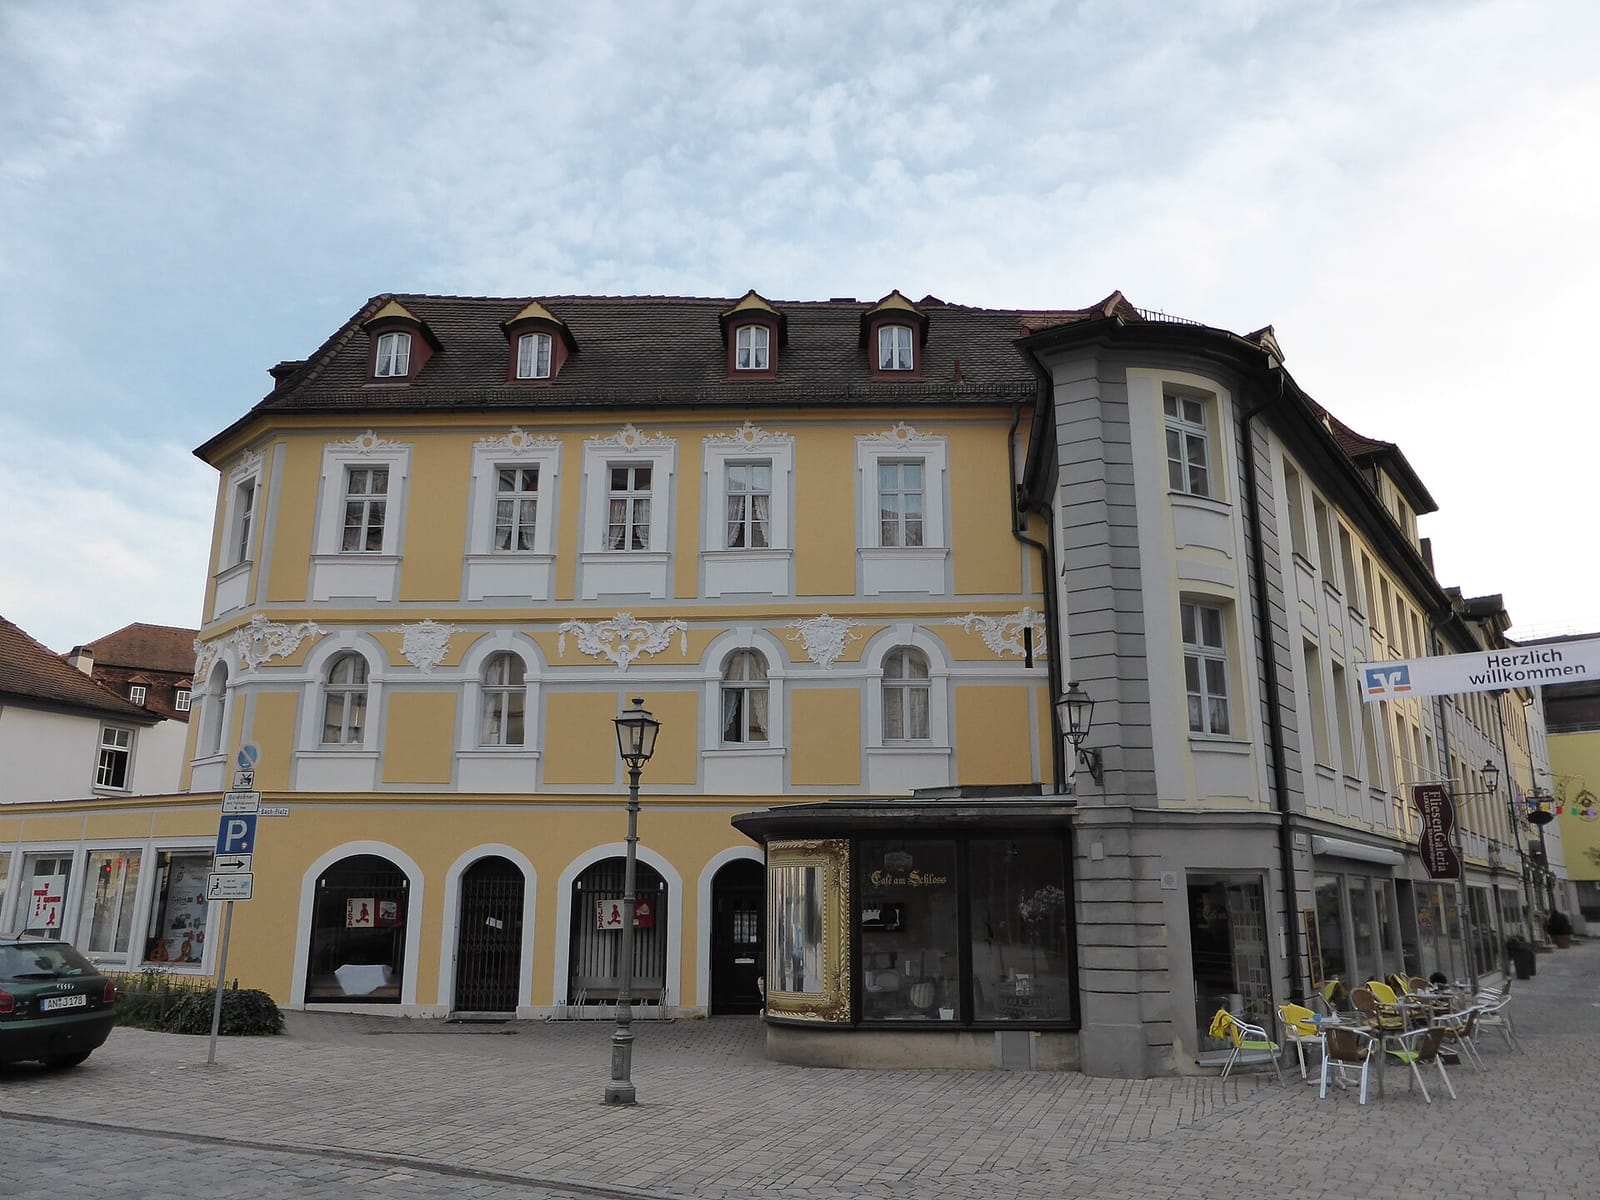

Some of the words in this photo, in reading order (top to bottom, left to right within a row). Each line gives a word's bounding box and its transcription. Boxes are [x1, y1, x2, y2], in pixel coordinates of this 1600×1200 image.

[1487, 649, 1563, 668] Herzlich
[1469, 664, 1586, 685] willkommen
[225, 820, 248, 851] P
[1429, 791, 1449, 872] FliesenGaleria
[47, 999, 58, 1009] AN
